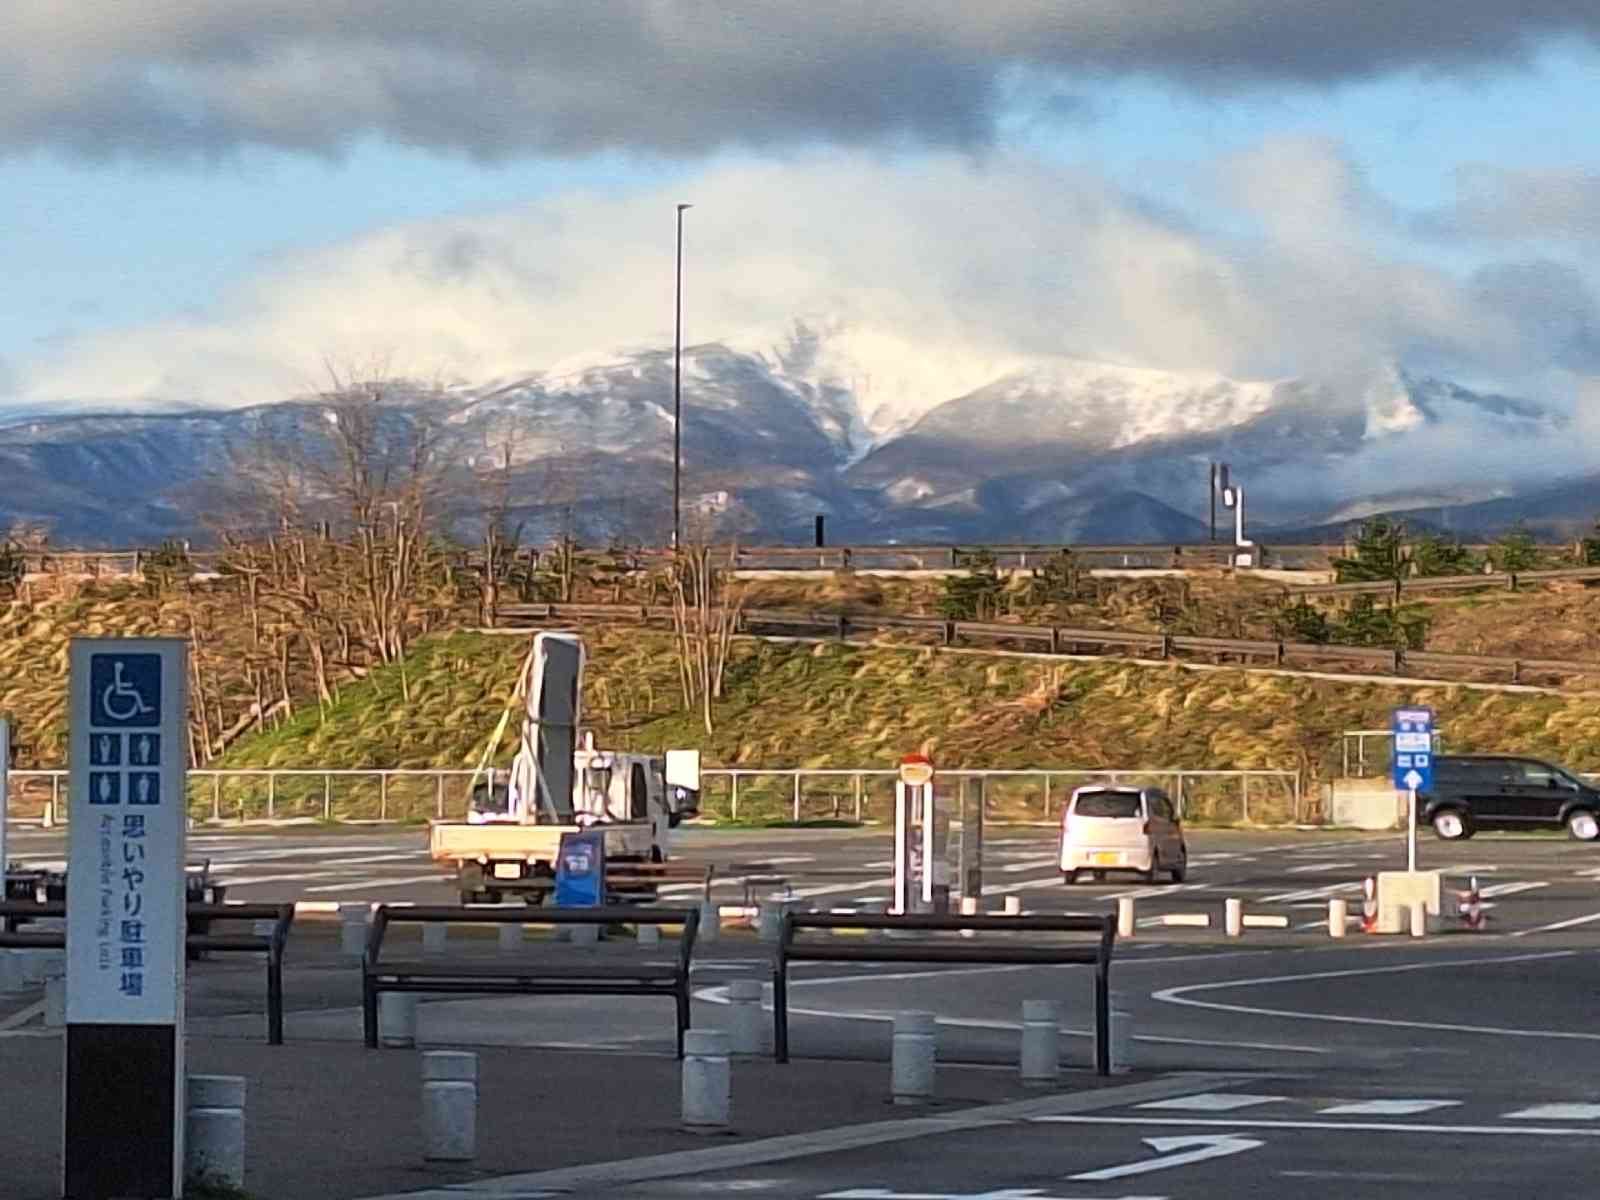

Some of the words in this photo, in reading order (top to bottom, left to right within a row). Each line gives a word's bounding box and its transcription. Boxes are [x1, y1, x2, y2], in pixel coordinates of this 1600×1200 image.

[119, 814, 146, 997] 思いやり駐車場
